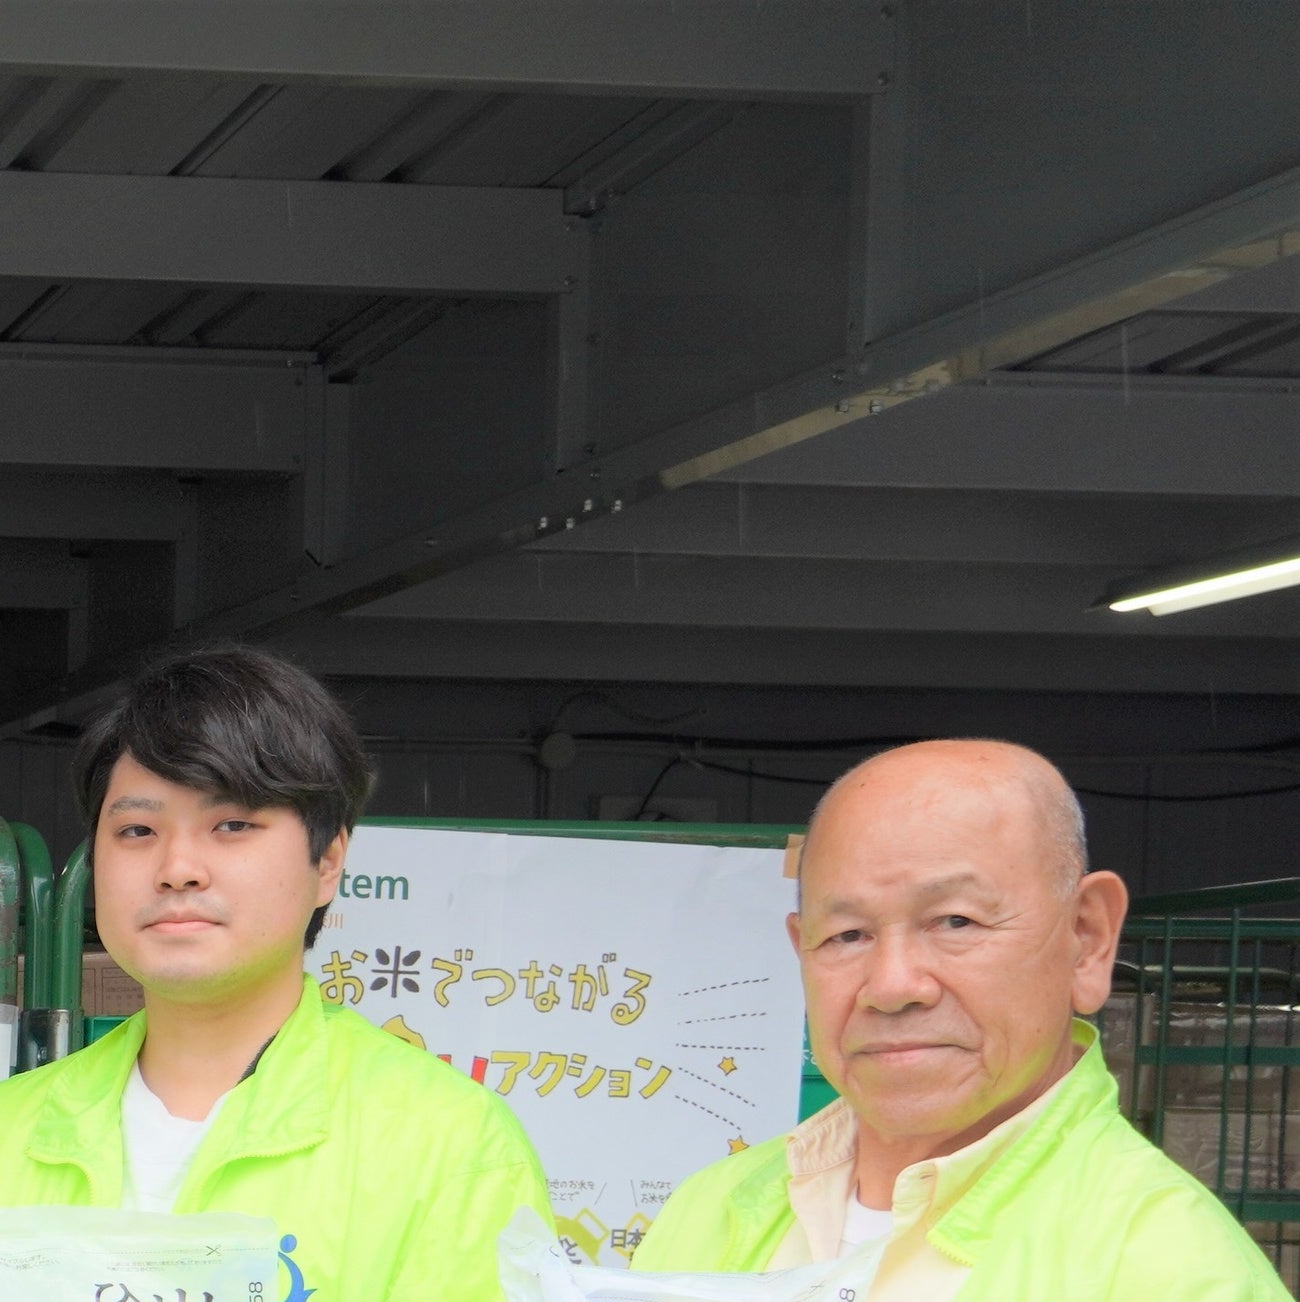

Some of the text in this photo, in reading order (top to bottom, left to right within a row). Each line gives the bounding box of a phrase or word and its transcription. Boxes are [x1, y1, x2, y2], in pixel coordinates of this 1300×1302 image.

[319, 945, 653, 1026] お米でつながる
